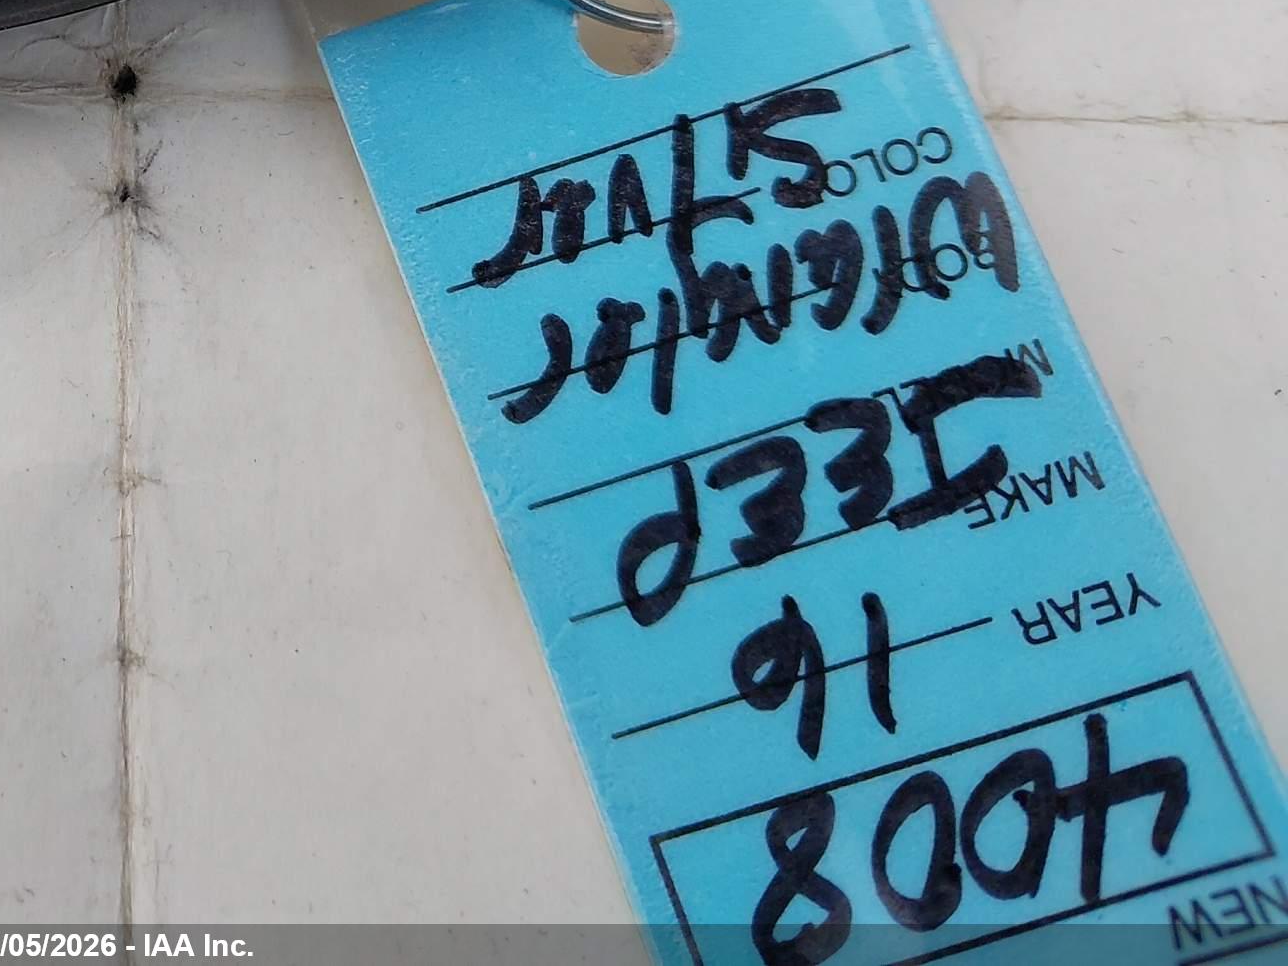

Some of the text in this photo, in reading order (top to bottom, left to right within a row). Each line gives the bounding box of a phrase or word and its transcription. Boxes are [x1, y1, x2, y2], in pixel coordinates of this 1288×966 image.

[816, 126, 954, 200] COLO
[963, 450, 1105, 530] MAKE
[1012, 571, 1162, 645] YEAR
[730, 591, 899, 761] 16
[750, 712, 1190, 966] 4008
[1166, 874, 1288, 952] NEW
